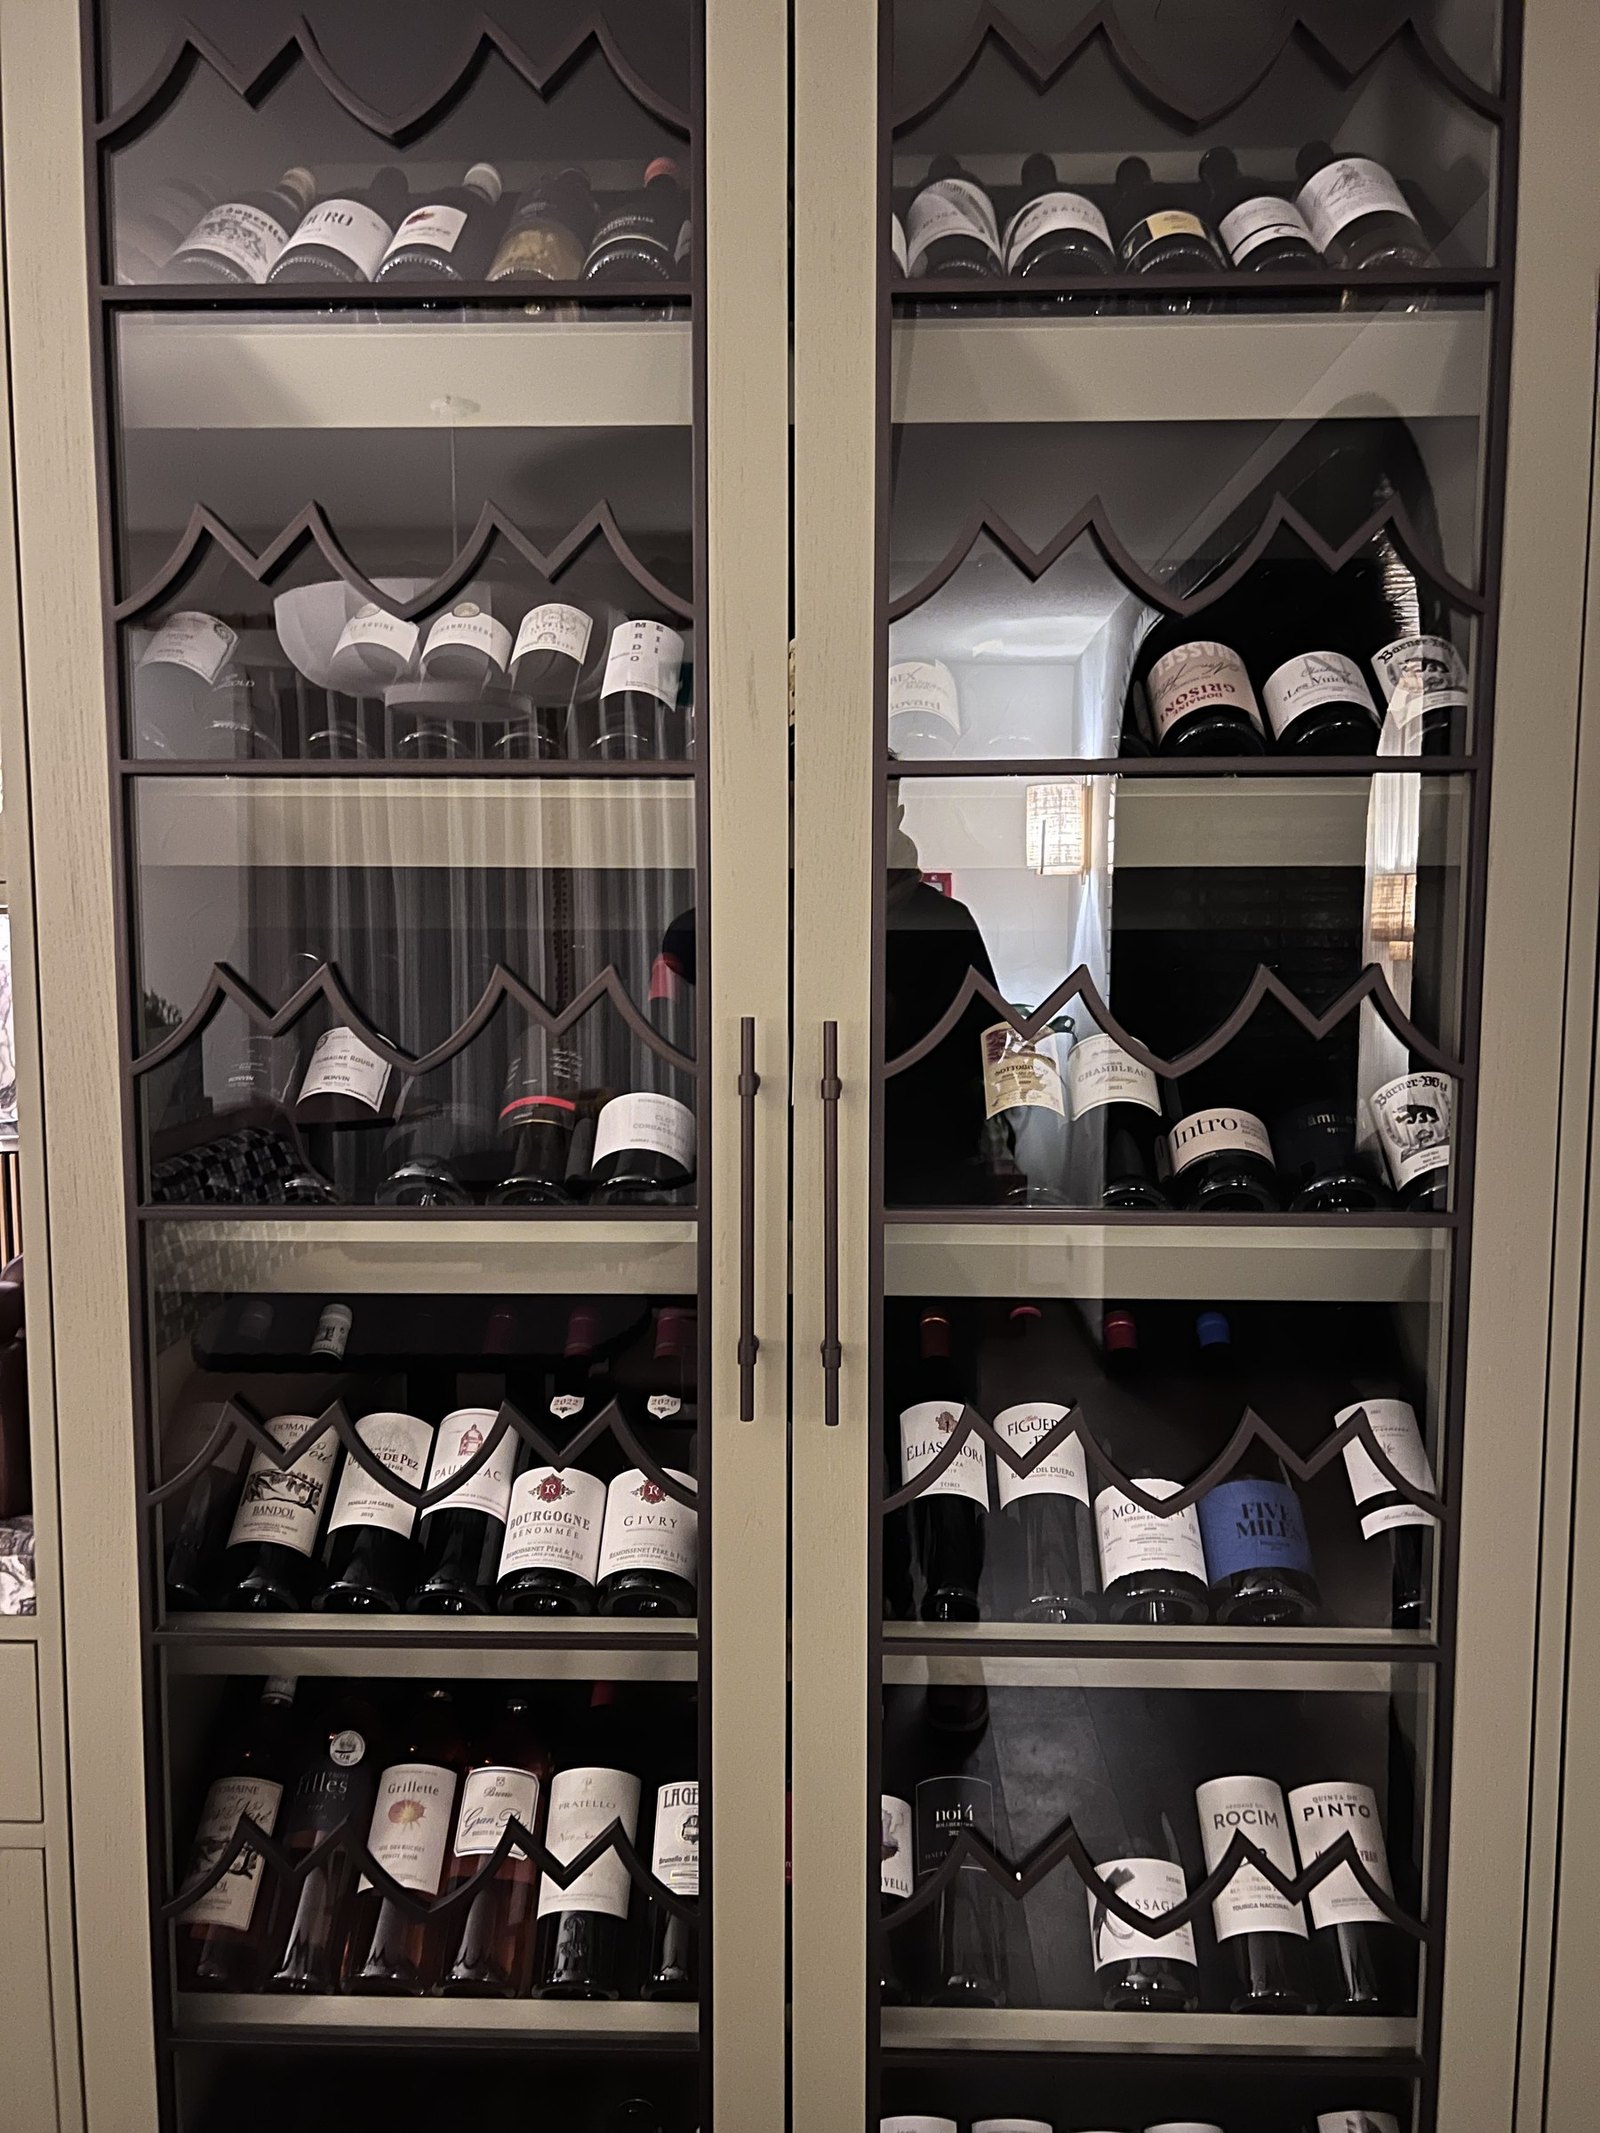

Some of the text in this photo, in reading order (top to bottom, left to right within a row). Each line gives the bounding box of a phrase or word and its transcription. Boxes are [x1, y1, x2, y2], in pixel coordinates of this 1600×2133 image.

[1078, 1063, 1148, 1083] CHAMBLEAU
[1174, 1117, 1239, 1150] Intro
[273, 1423, 310, 1433] DOMAI
[1007, 1418, 1062, 1437] FIGUER
[383, 1452, 398, 1463] DE
[400, 1453, 419, 1471] PEZ
[251, 1505, 296, 1520] BANDOL
[509, 1510, 591, 1531] BOURGOGNE
[623, 1515, 679, 1529] GIVRY
[512, 1526, 580, 1541] RENOMMÉE
[387, 1780, 440, 1797] Grillette
[558, 1799, 617, 1810] FRATELLO
[935, 1803, 962, 1822] noi
[1303, 1802, 1371, 1822] PINTO
[1213, 1809, 1280, 1831] ROCIM
[658, 1853, 683, 1865] Brunello
